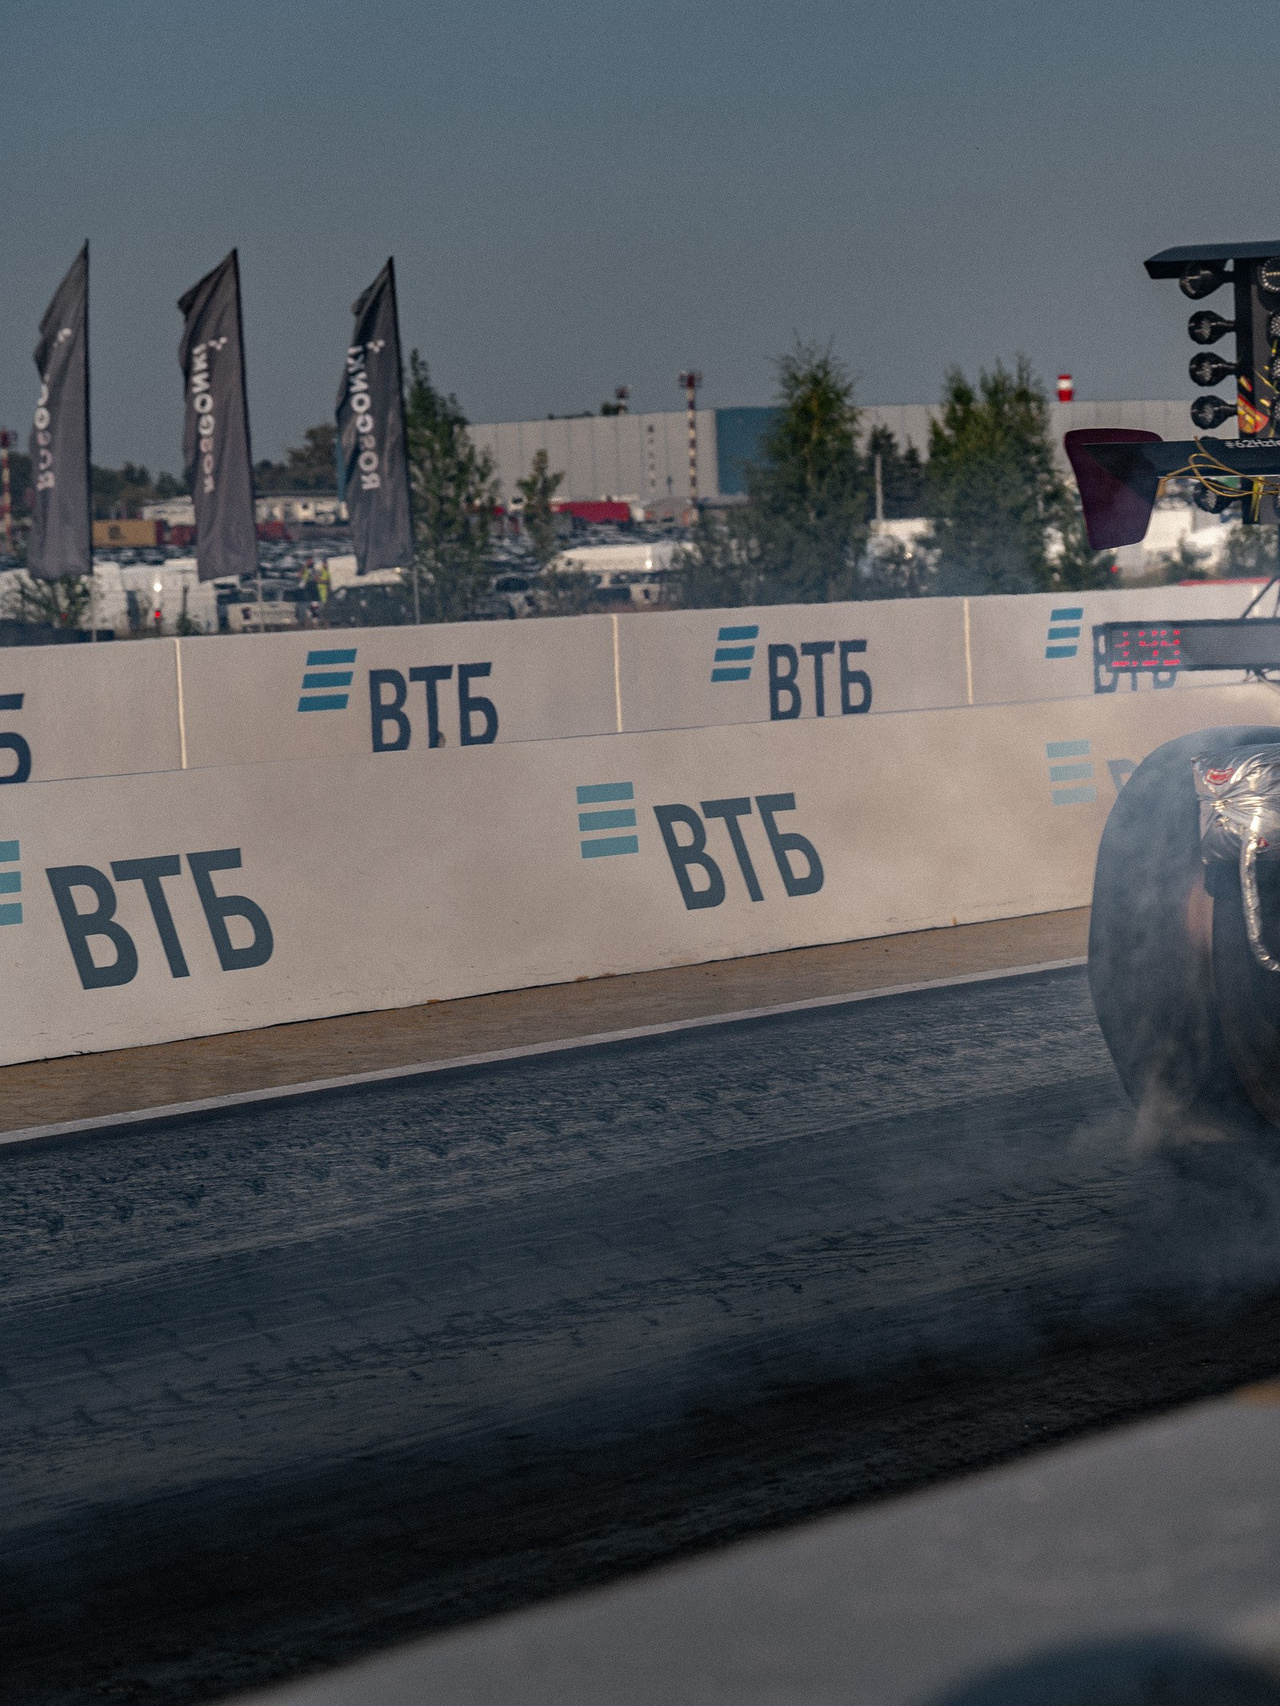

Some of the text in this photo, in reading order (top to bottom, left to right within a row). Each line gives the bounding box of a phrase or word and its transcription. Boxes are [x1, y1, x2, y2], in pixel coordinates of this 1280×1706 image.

[369, 662, 498, 752] ВТБ
[768, 640, 873, 721] ВТБ
[653, 793, 824, 910] ВТБ
[45, 848, 273, 990] ВТБ
